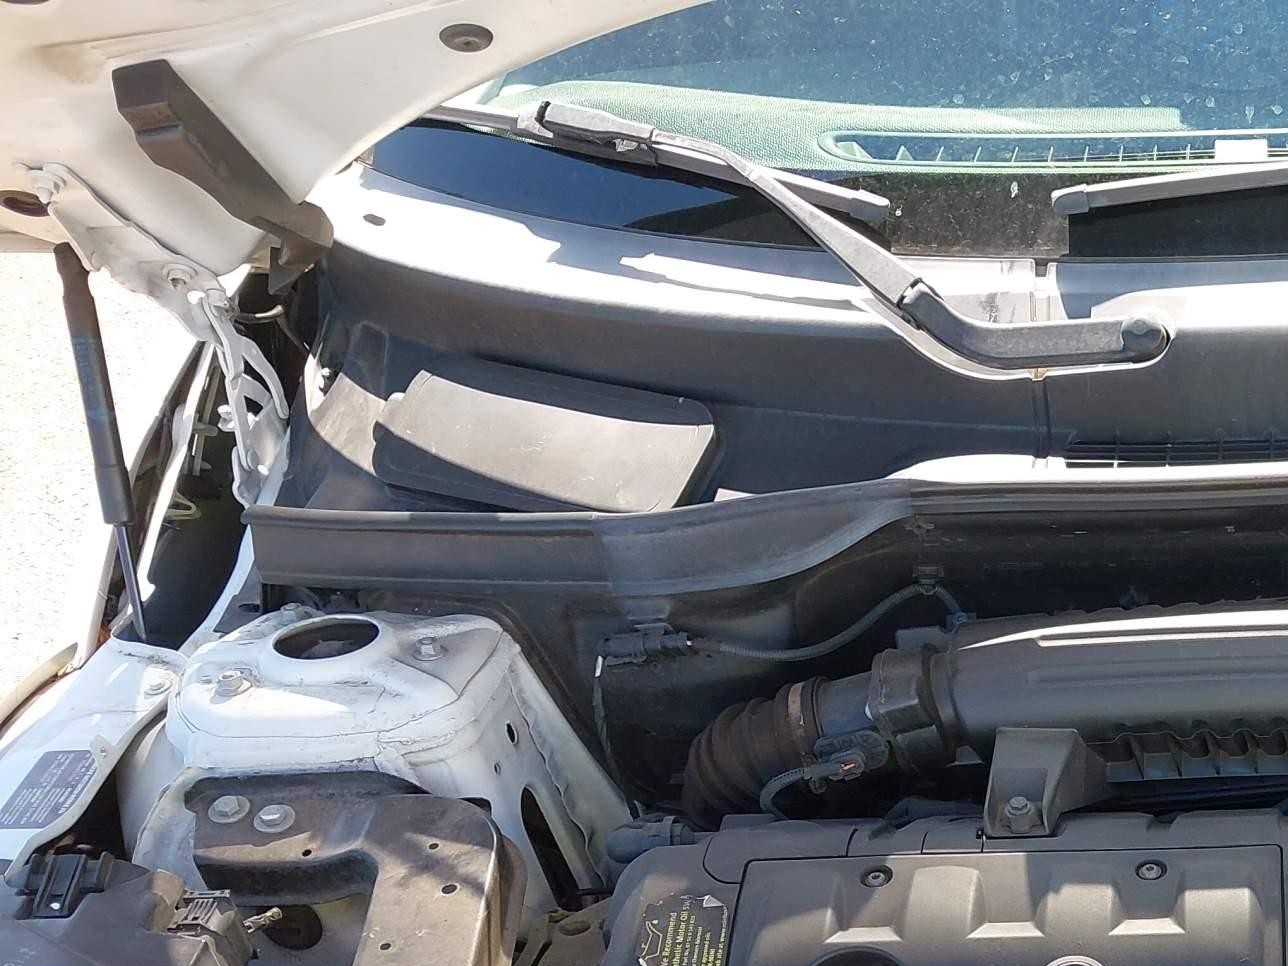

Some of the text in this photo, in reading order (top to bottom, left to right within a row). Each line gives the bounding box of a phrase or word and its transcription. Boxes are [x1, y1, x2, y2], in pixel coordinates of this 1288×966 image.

[680, 911, 688, 921] Oil
[662, 912, 677, 956] Recommend
[676, 921, 687, 943] Motor
